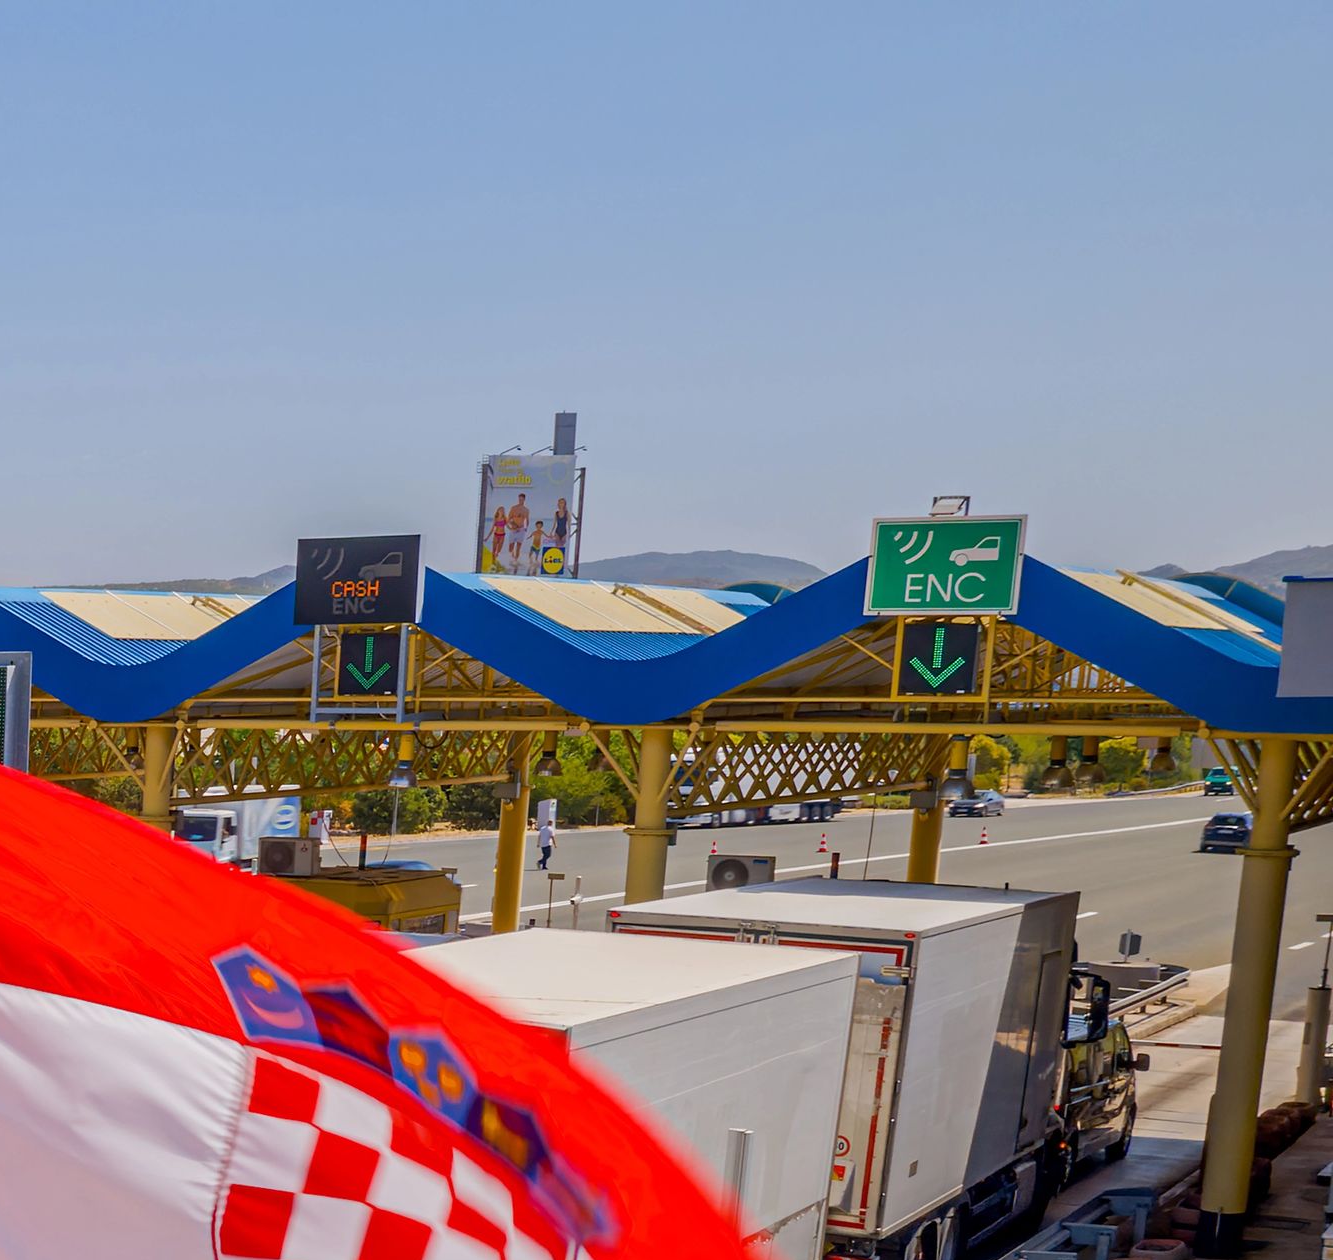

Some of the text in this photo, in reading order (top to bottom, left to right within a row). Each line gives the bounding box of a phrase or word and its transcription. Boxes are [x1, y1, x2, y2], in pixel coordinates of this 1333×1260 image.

[331, 580, 380, 598] CASH
[904, 572, 986, 603] ENC
[333, 597, 377, 615] ENC
